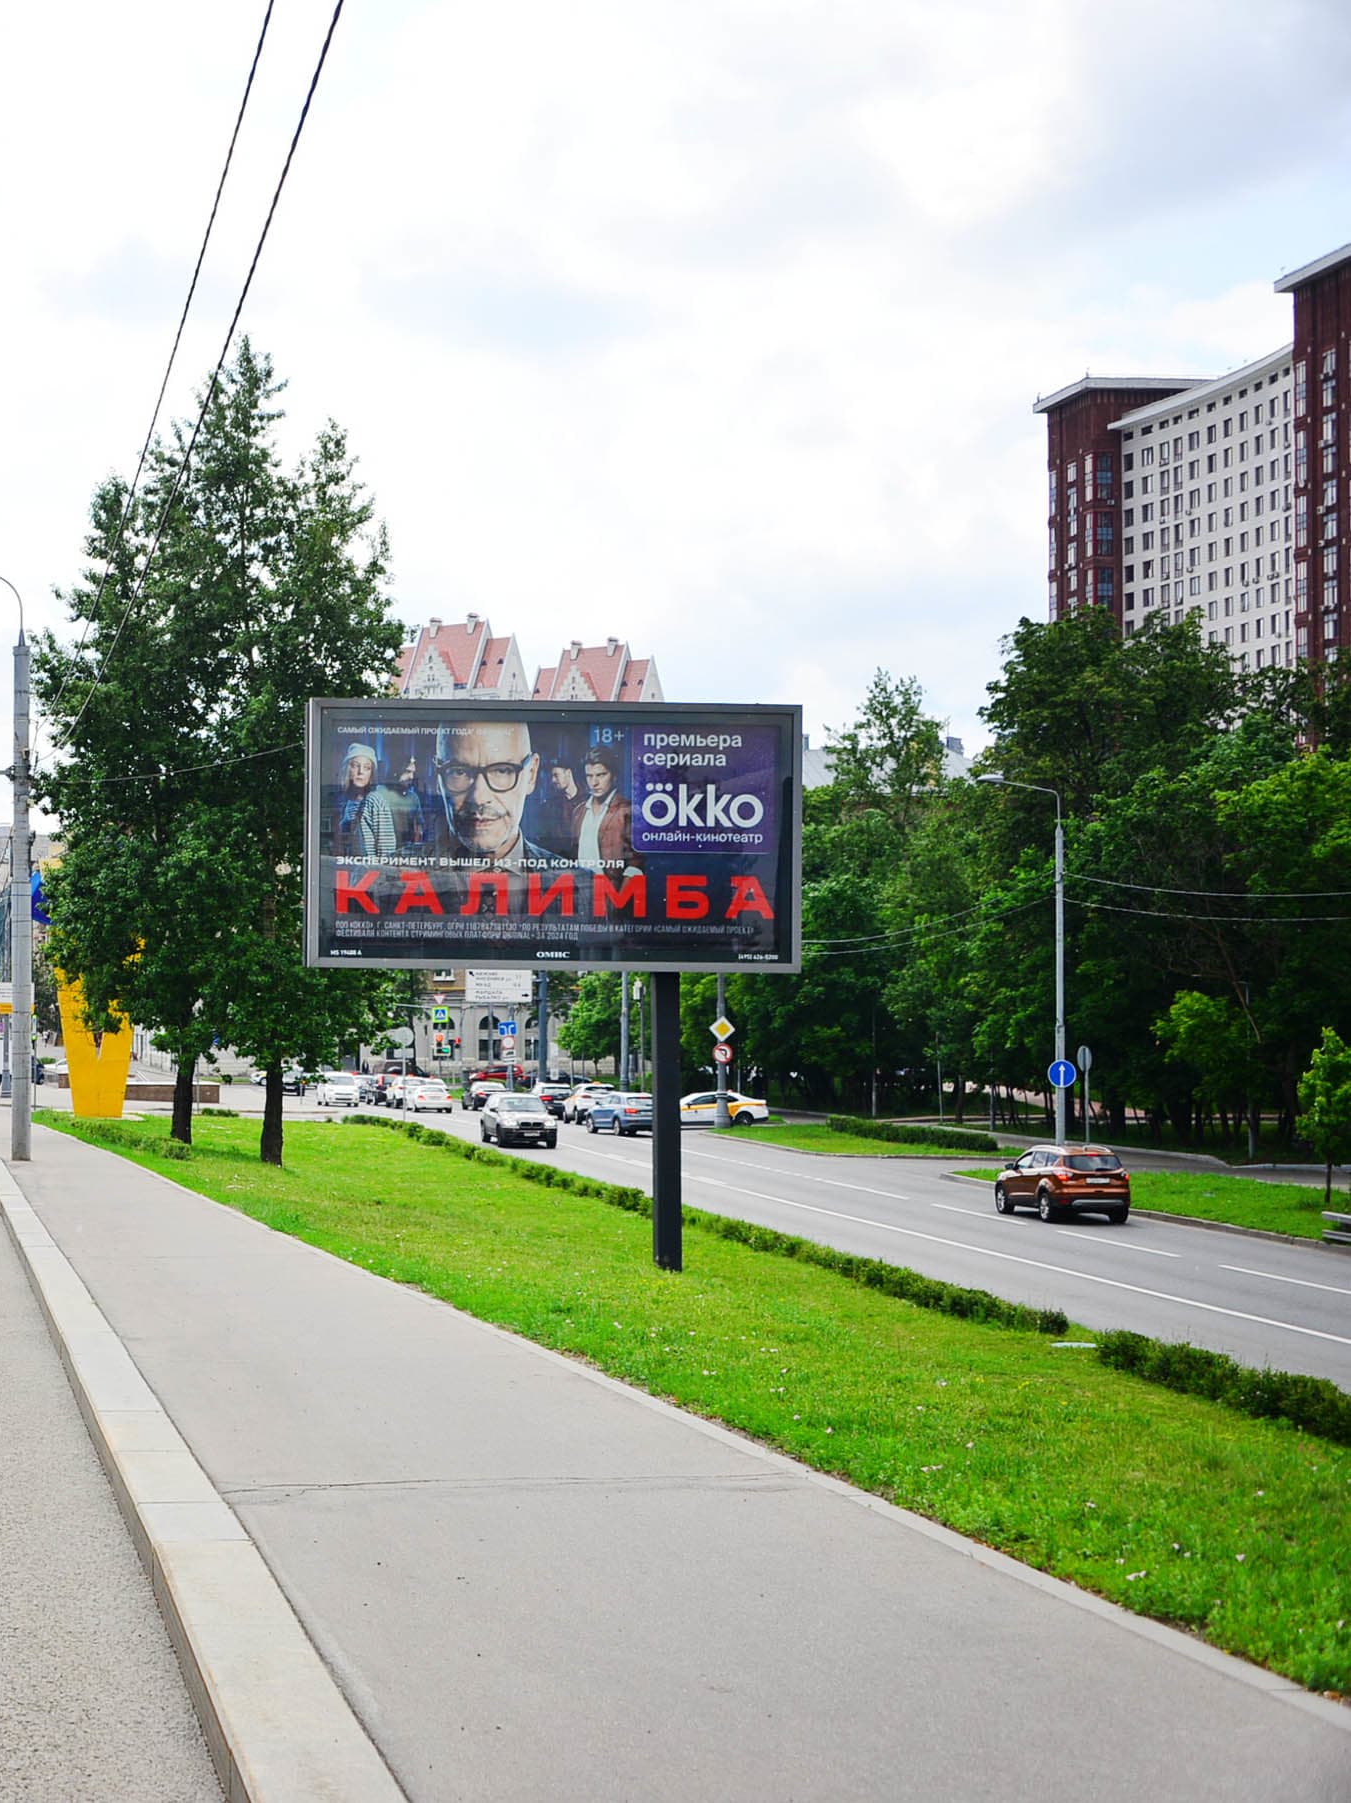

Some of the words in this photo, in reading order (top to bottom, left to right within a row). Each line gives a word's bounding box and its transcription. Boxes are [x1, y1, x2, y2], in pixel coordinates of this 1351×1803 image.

[593, 729, 625, 744] 18+
[643, 732, 742, 750] премьера
[643, 752, 726, 769] сериала
[642, 830, 763, 844] онлайн-кинотеатр
[336, 855, 437, 867] ЭКСПЕРИМЕНТ
[439, 857, 490, 868] ВЫШЕЛ
[494, 858, 548, 869] ИЗ-ПОД
[335, 870, 775, 920] КАЛИМБА
